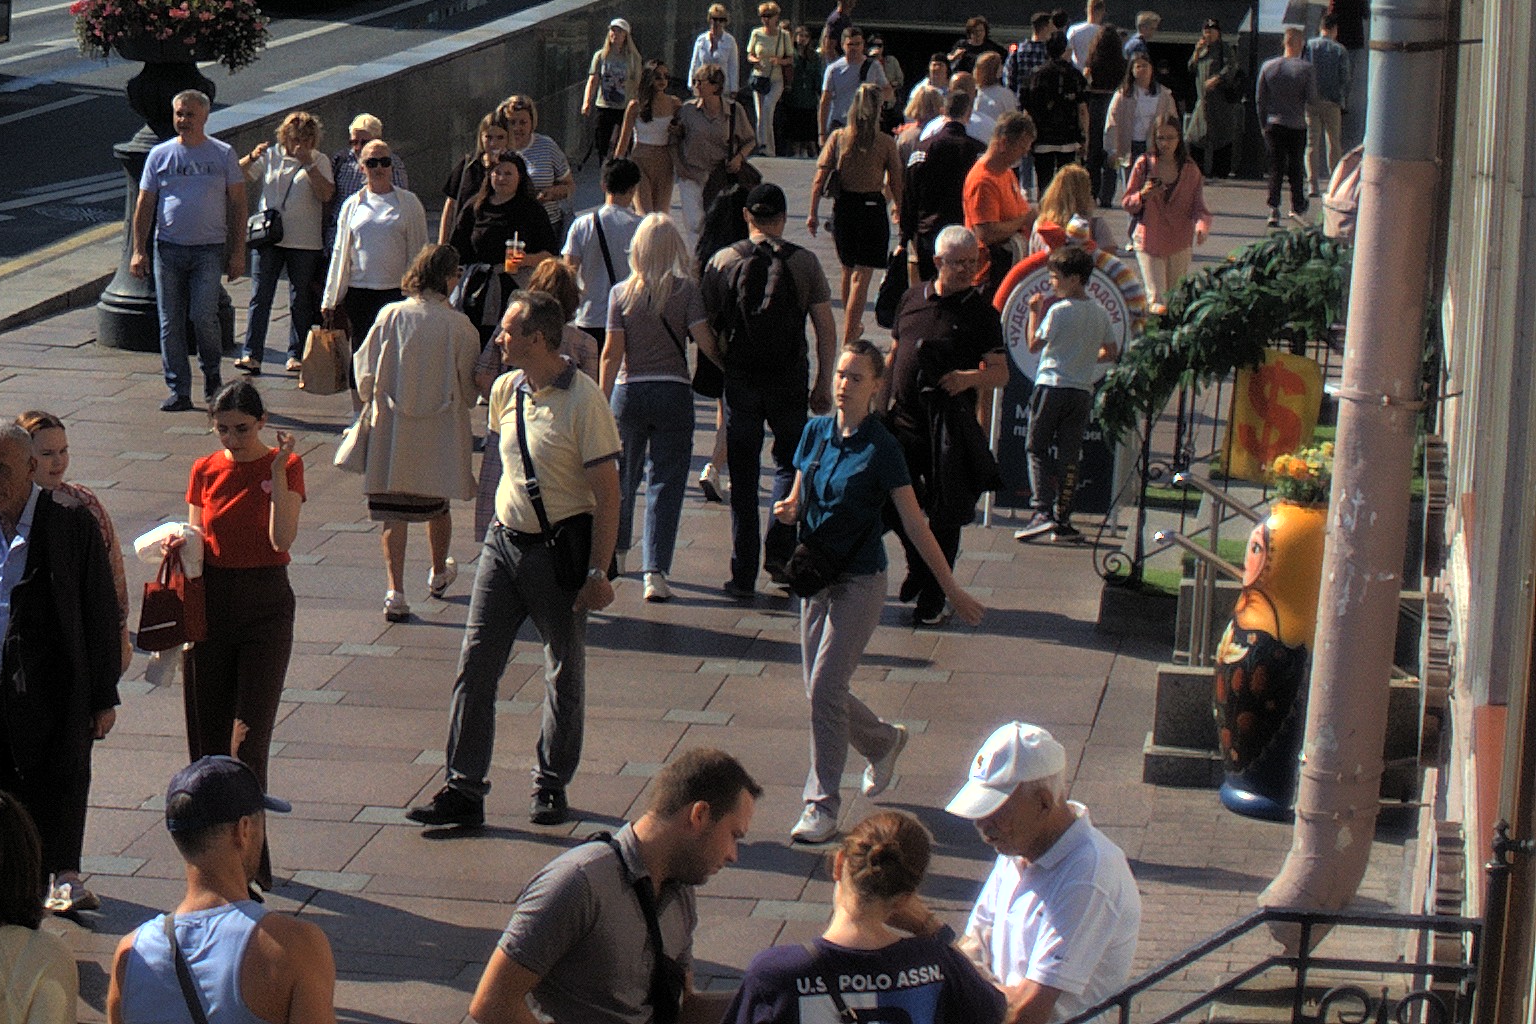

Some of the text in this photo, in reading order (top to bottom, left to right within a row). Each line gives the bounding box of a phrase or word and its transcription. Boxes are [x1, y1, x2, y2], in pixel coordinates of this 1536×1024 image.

[1009, 279, 1122, 349] ЧУДЕСНО ЯДОМ
[796, 964, 945, 995] U.S POLO ASSN.
